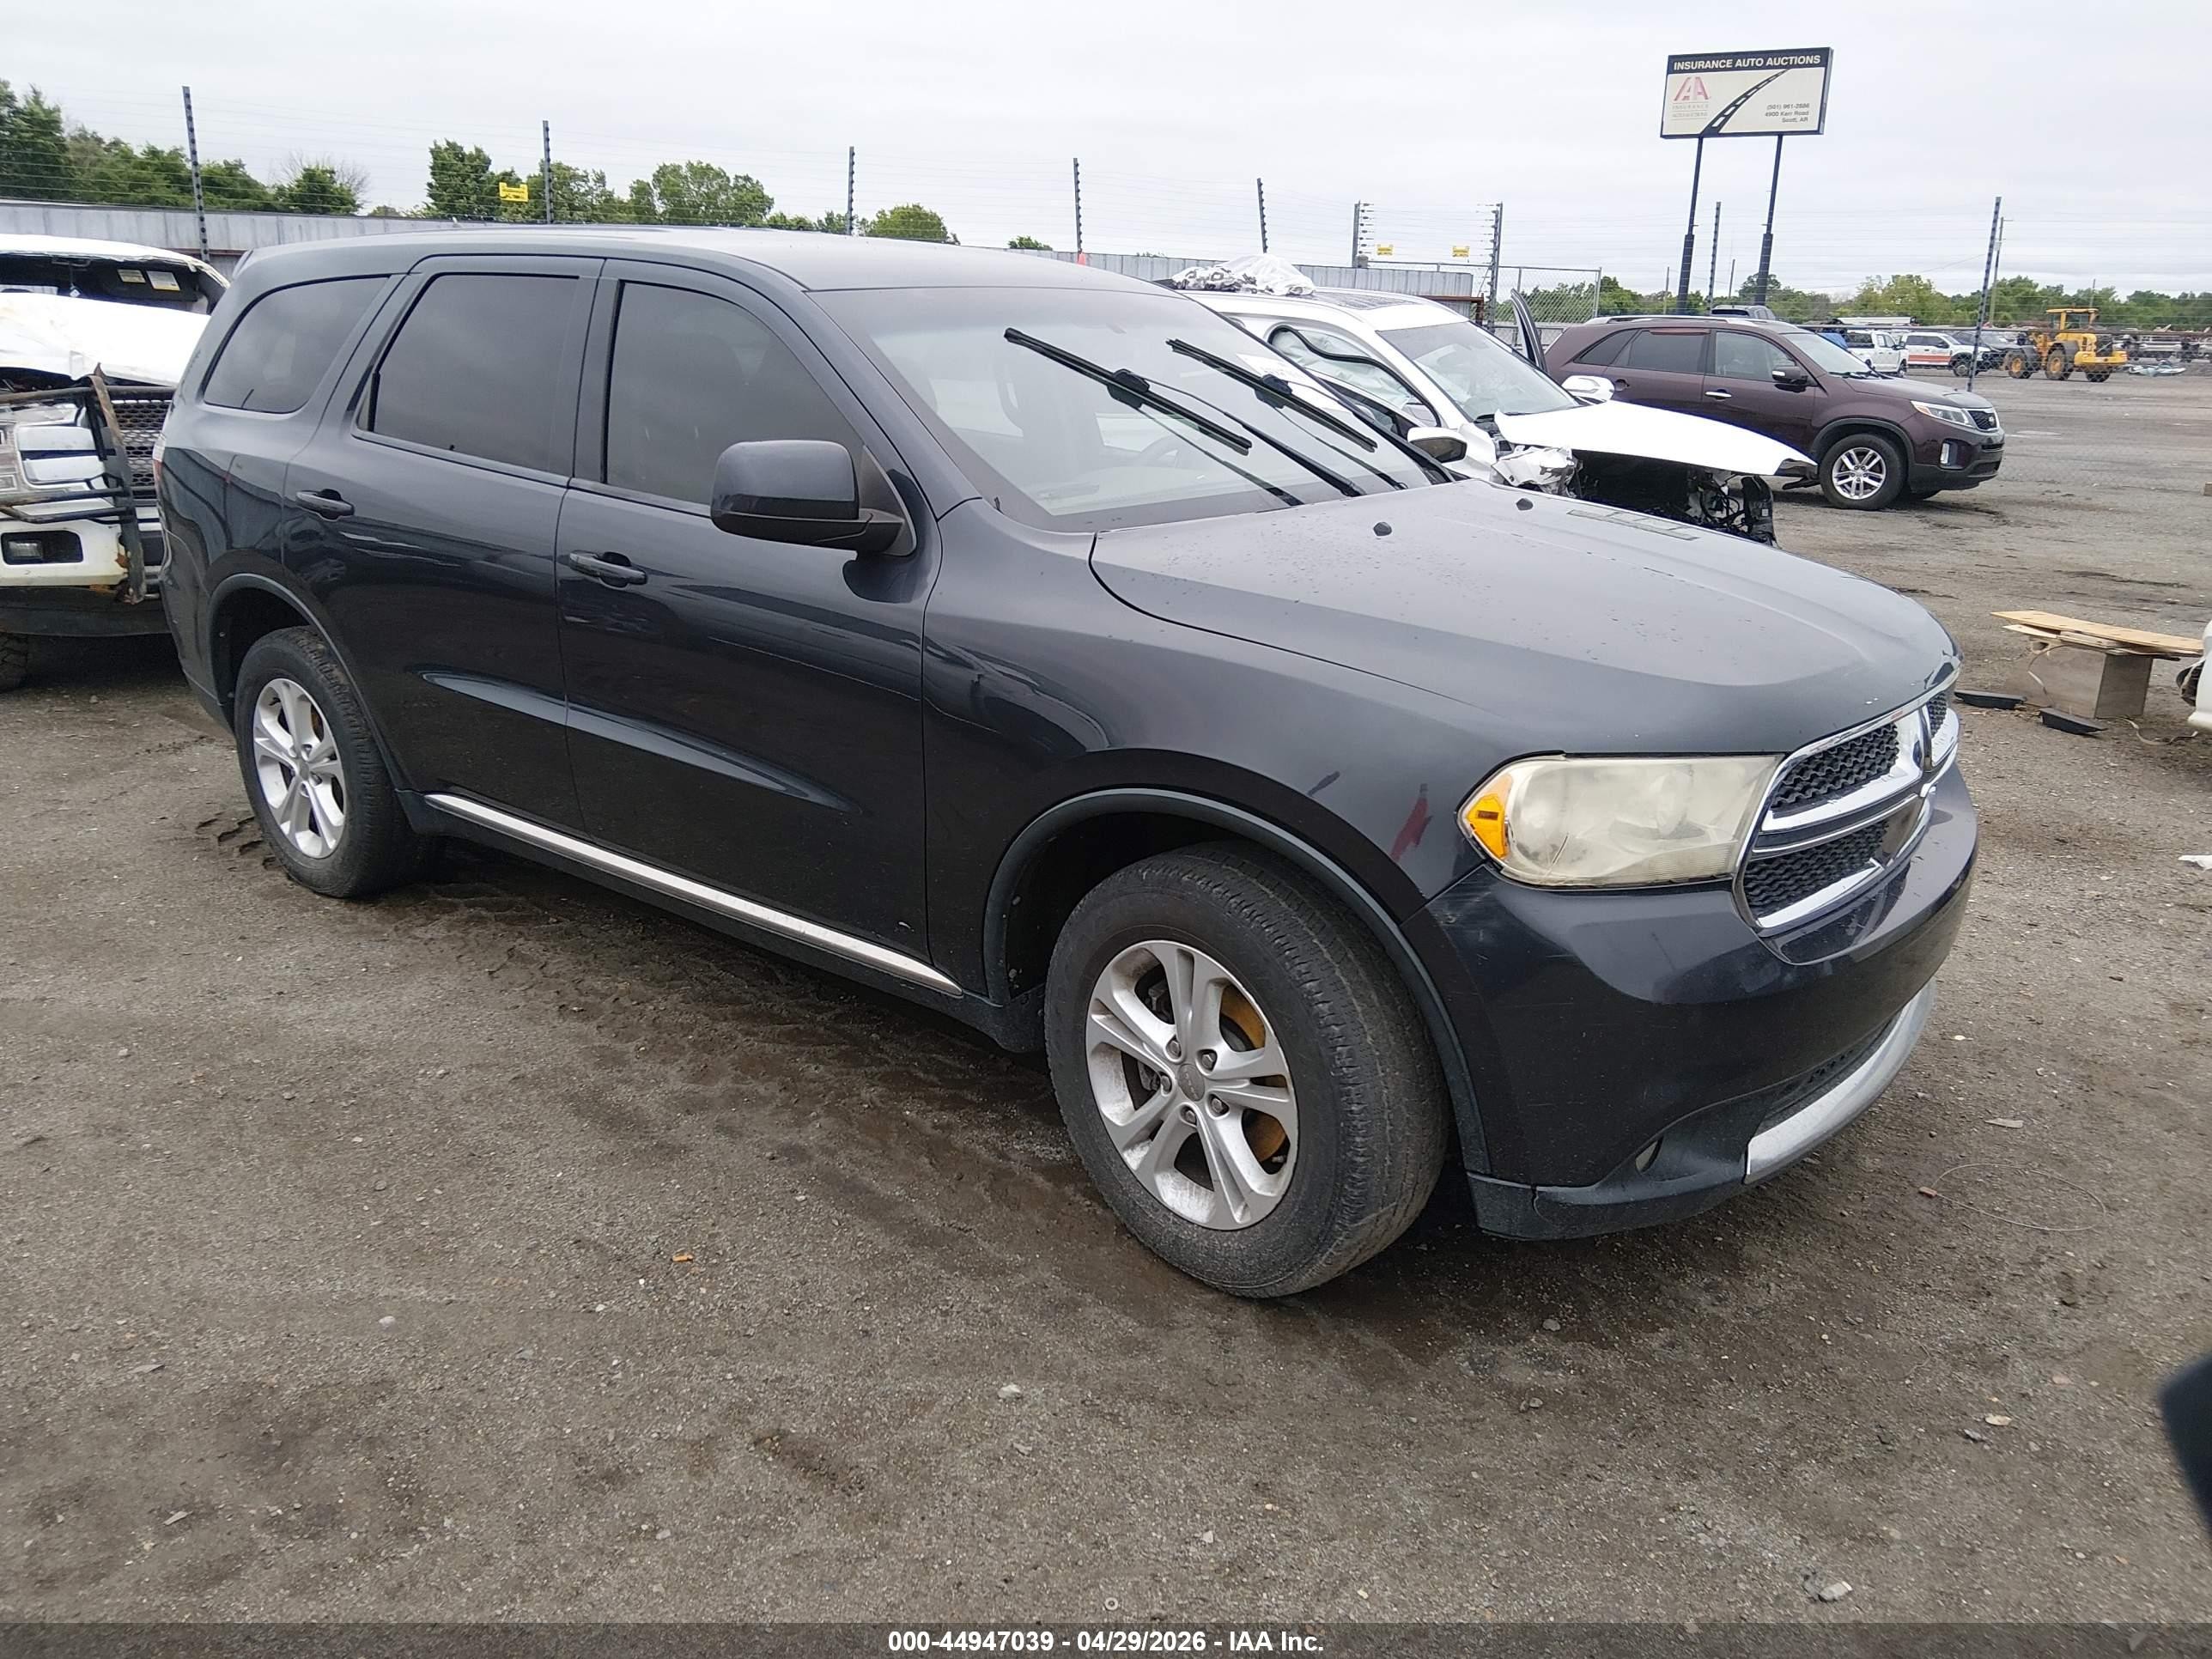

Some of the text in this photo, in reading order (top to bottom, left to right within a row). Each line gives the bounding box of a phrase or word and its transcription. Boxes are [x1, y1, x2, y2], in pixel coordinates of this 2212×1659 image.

[1674, 55, 1821, 70] INSURANCE AUTO AUCTIONS
